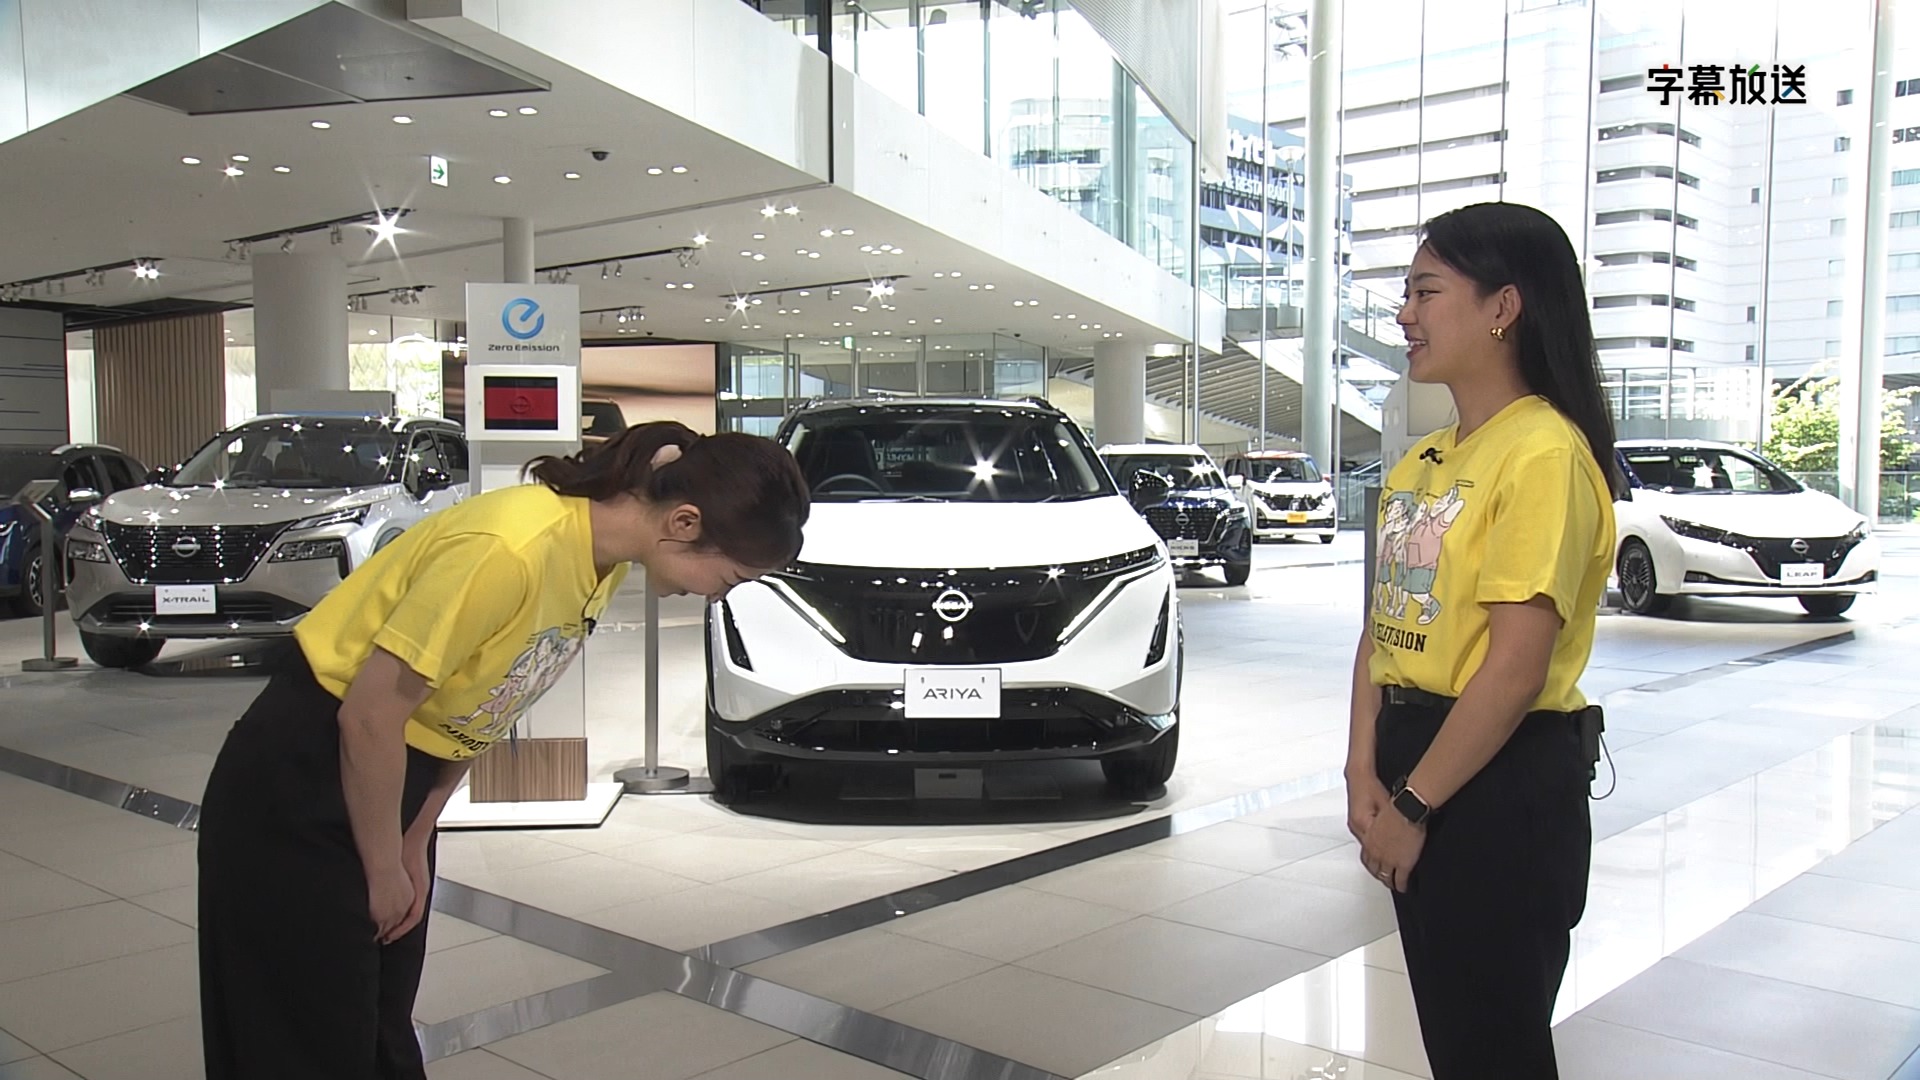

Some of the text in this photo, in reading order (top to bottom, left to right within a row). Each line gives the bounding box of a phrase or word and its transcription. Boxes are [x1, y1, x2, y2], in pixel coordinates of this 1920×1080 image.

[488, 344, 560, 352] Zero Emission
[923, 688, 982, 699] ARIYA
